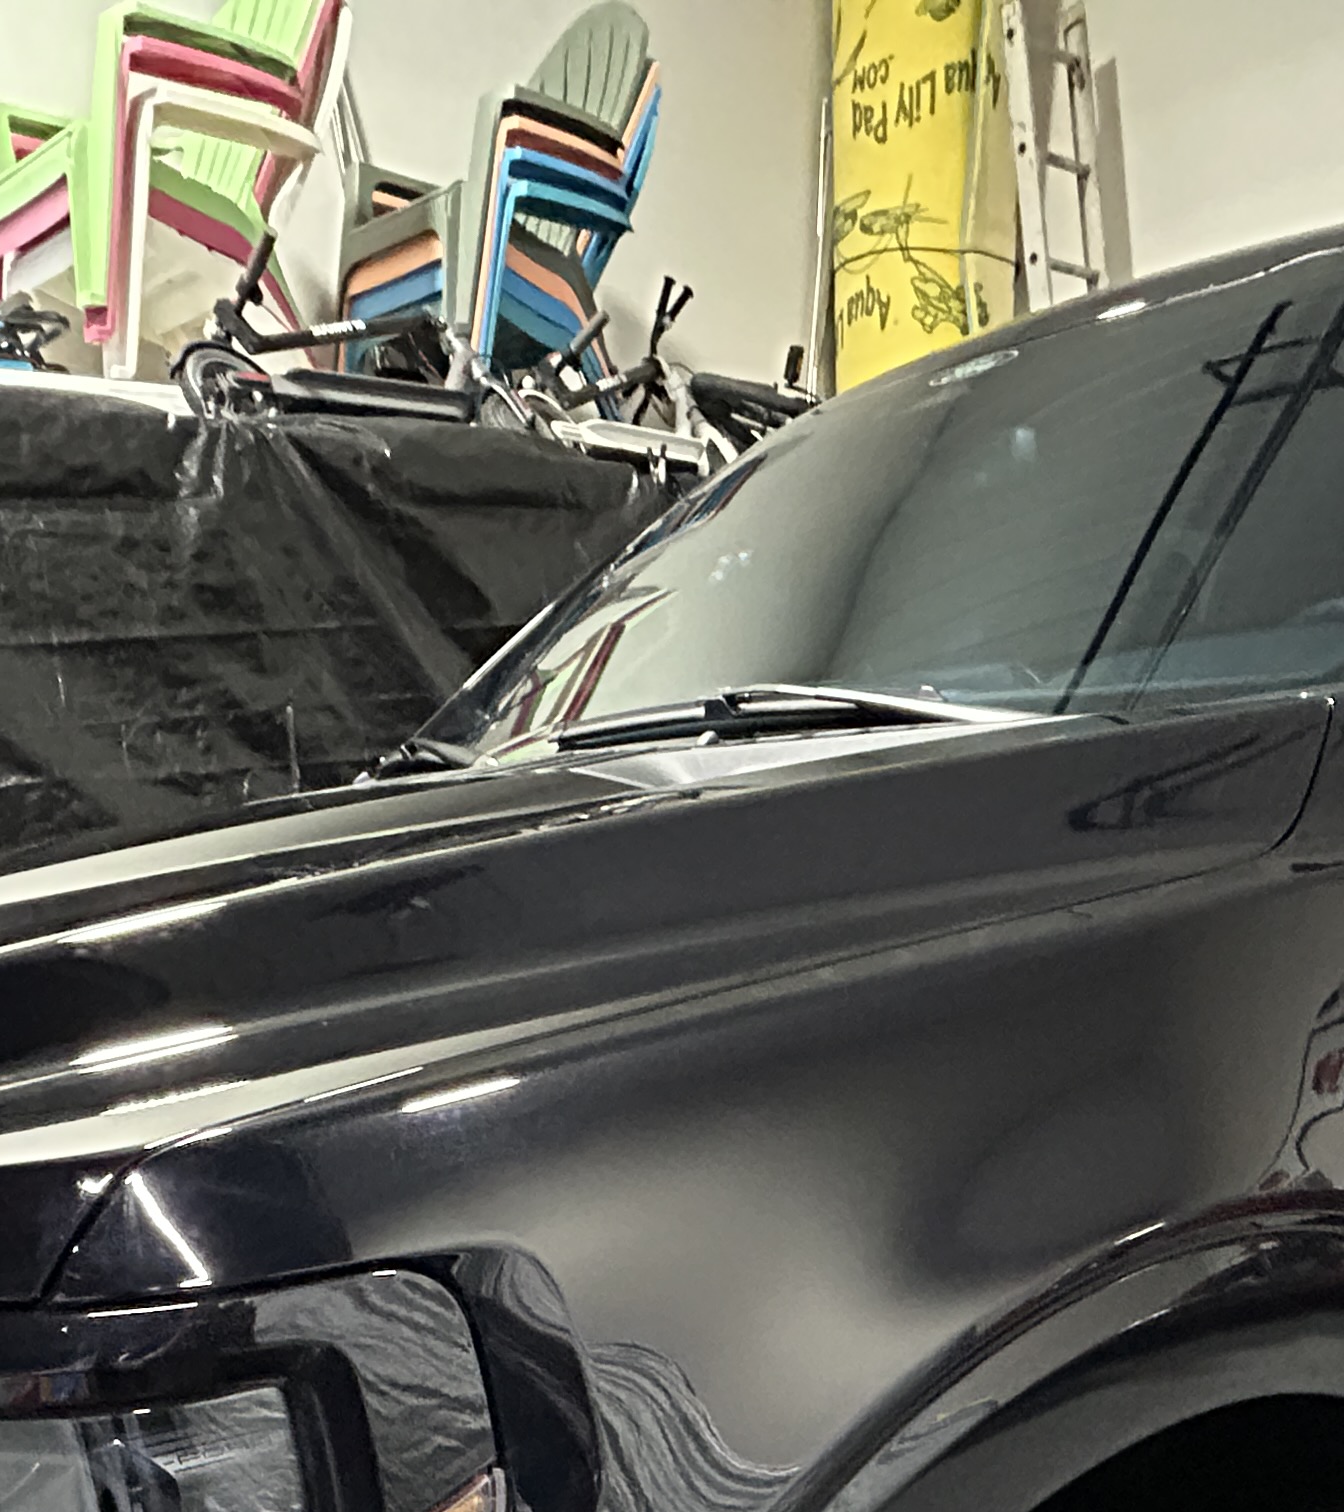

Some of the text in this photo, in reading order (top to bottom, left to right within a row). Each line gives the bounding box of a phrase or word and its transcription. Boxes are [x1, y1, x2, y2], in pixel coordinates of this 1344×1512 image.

[851, 99, 888, 145] Pad
[894, 69, 937, 129] Lily
[847, 274, 891, 331] Aqua
